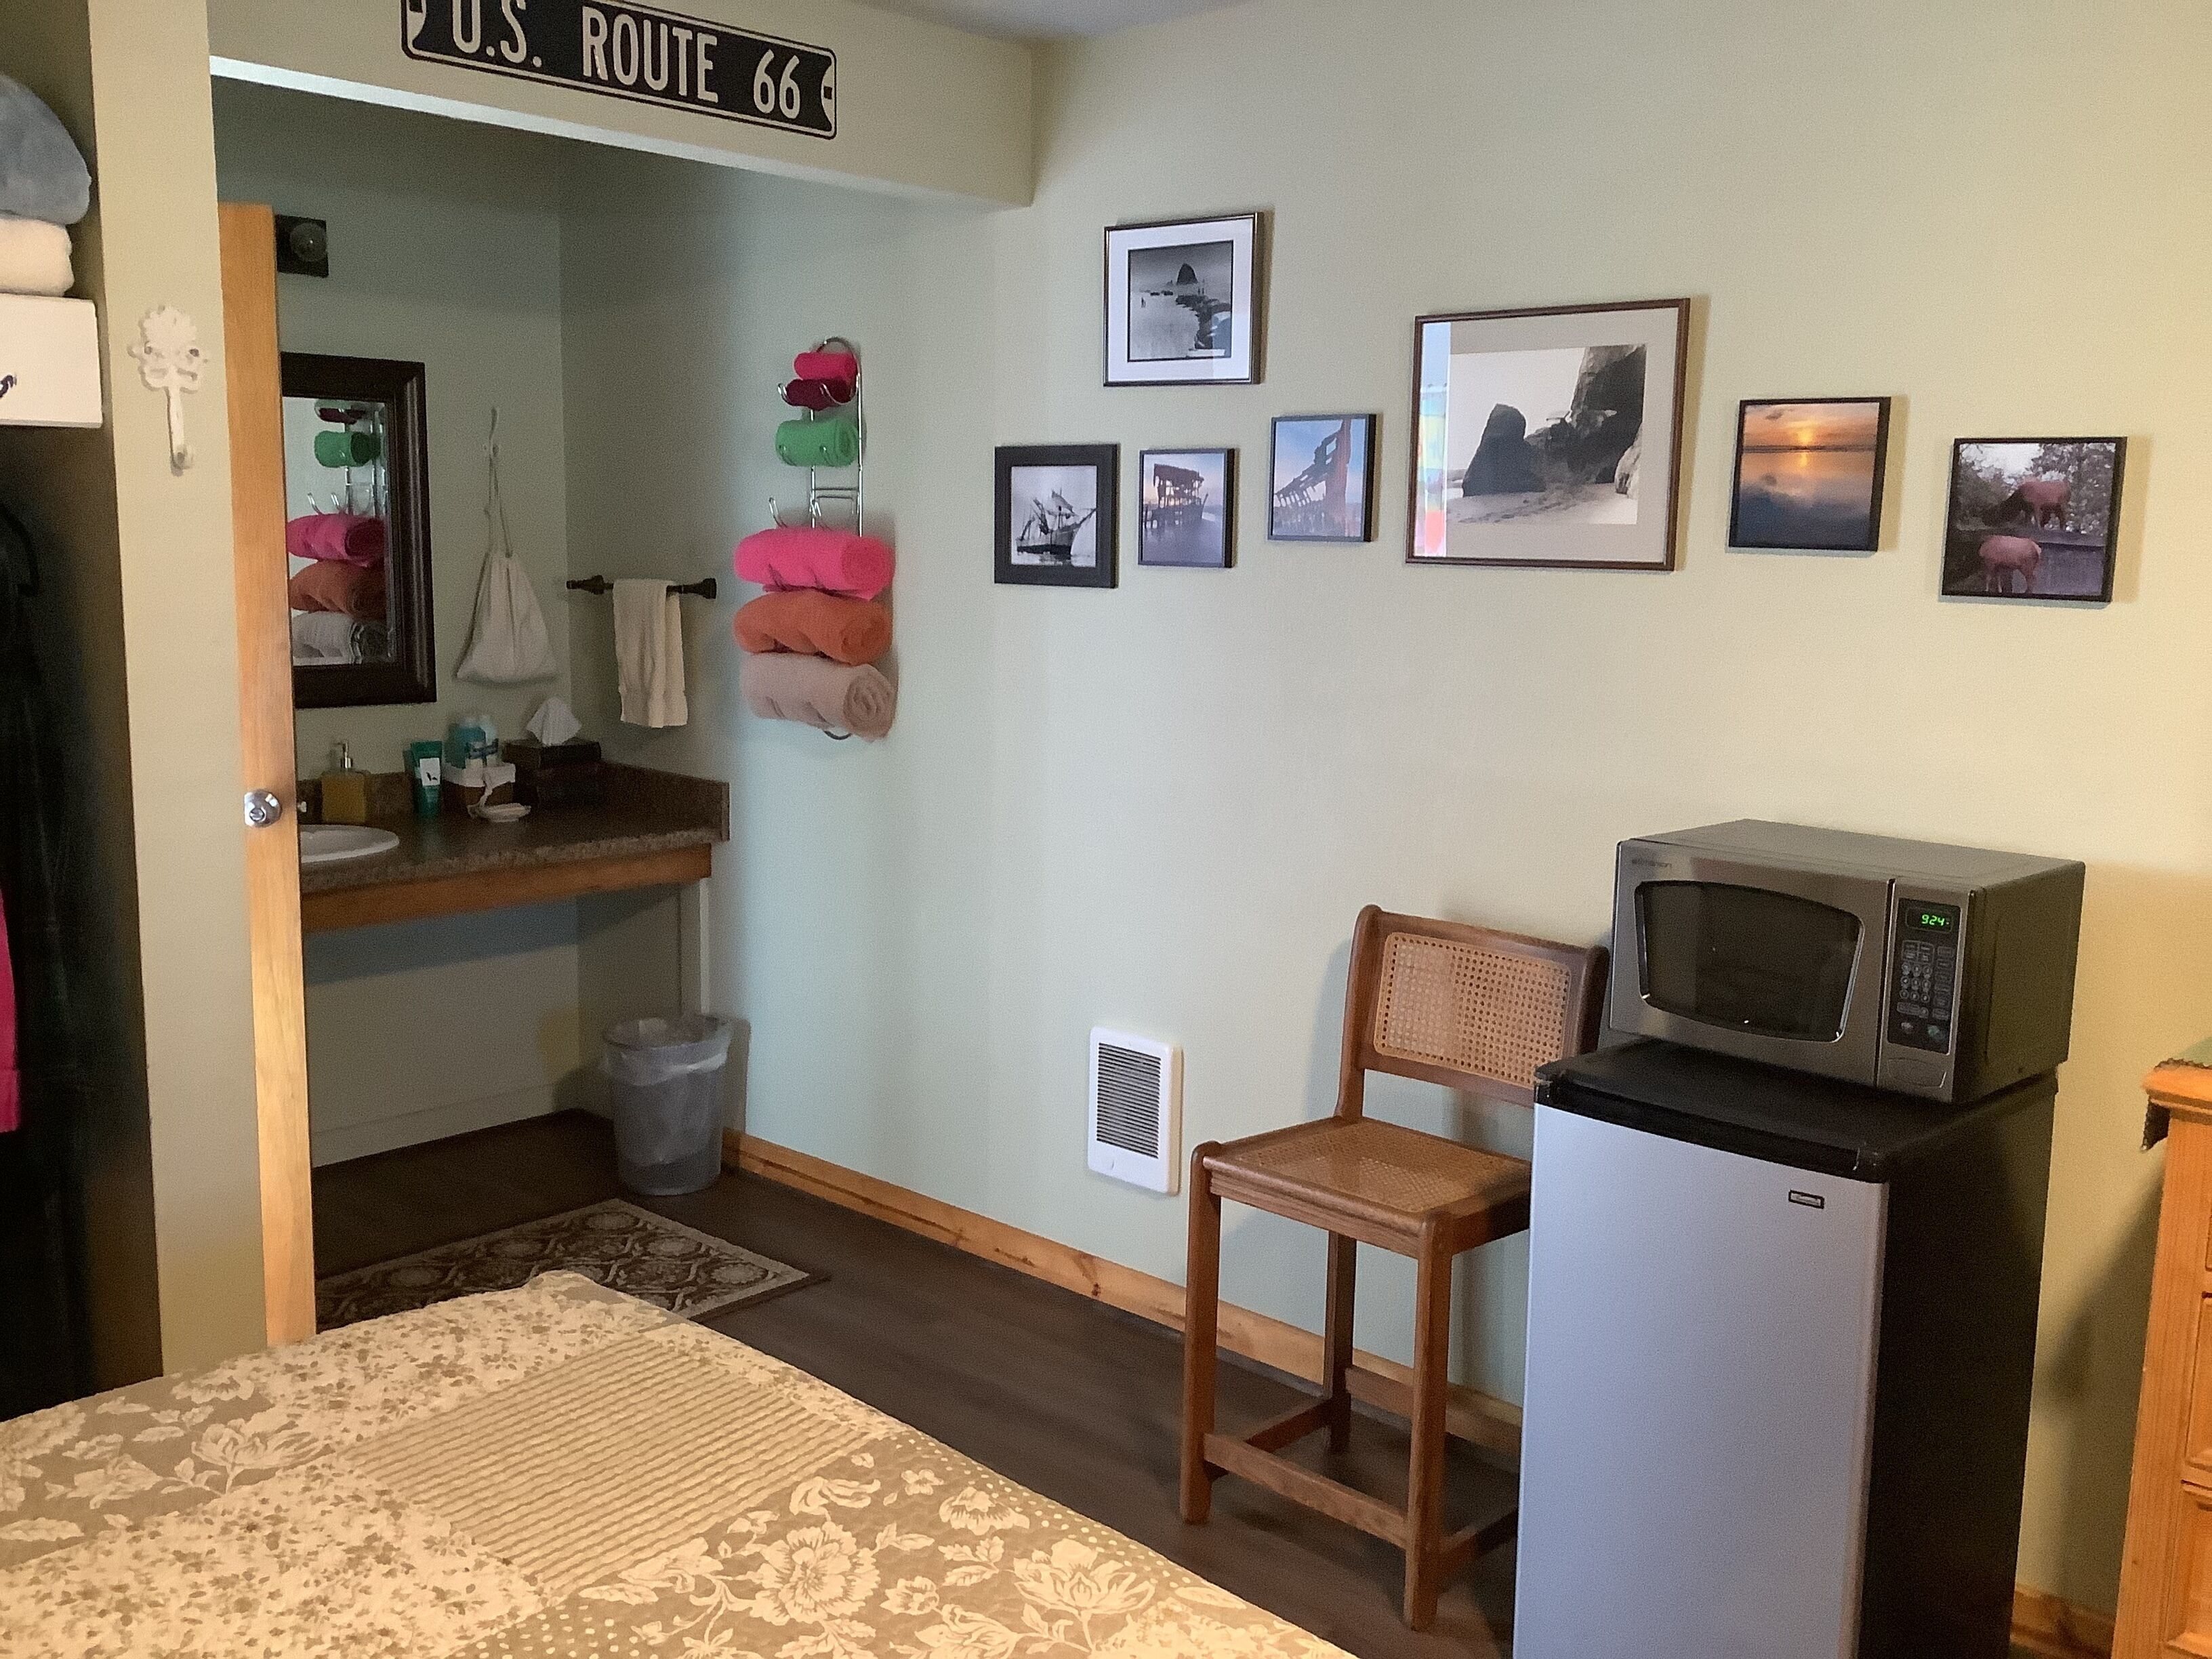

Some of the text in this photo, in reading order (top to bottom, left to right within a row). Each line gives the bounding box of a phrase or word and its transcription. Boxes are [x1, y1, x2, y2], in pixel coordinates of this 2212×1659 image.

[453, 0, 800, 119] U.S. ROUTE 66
